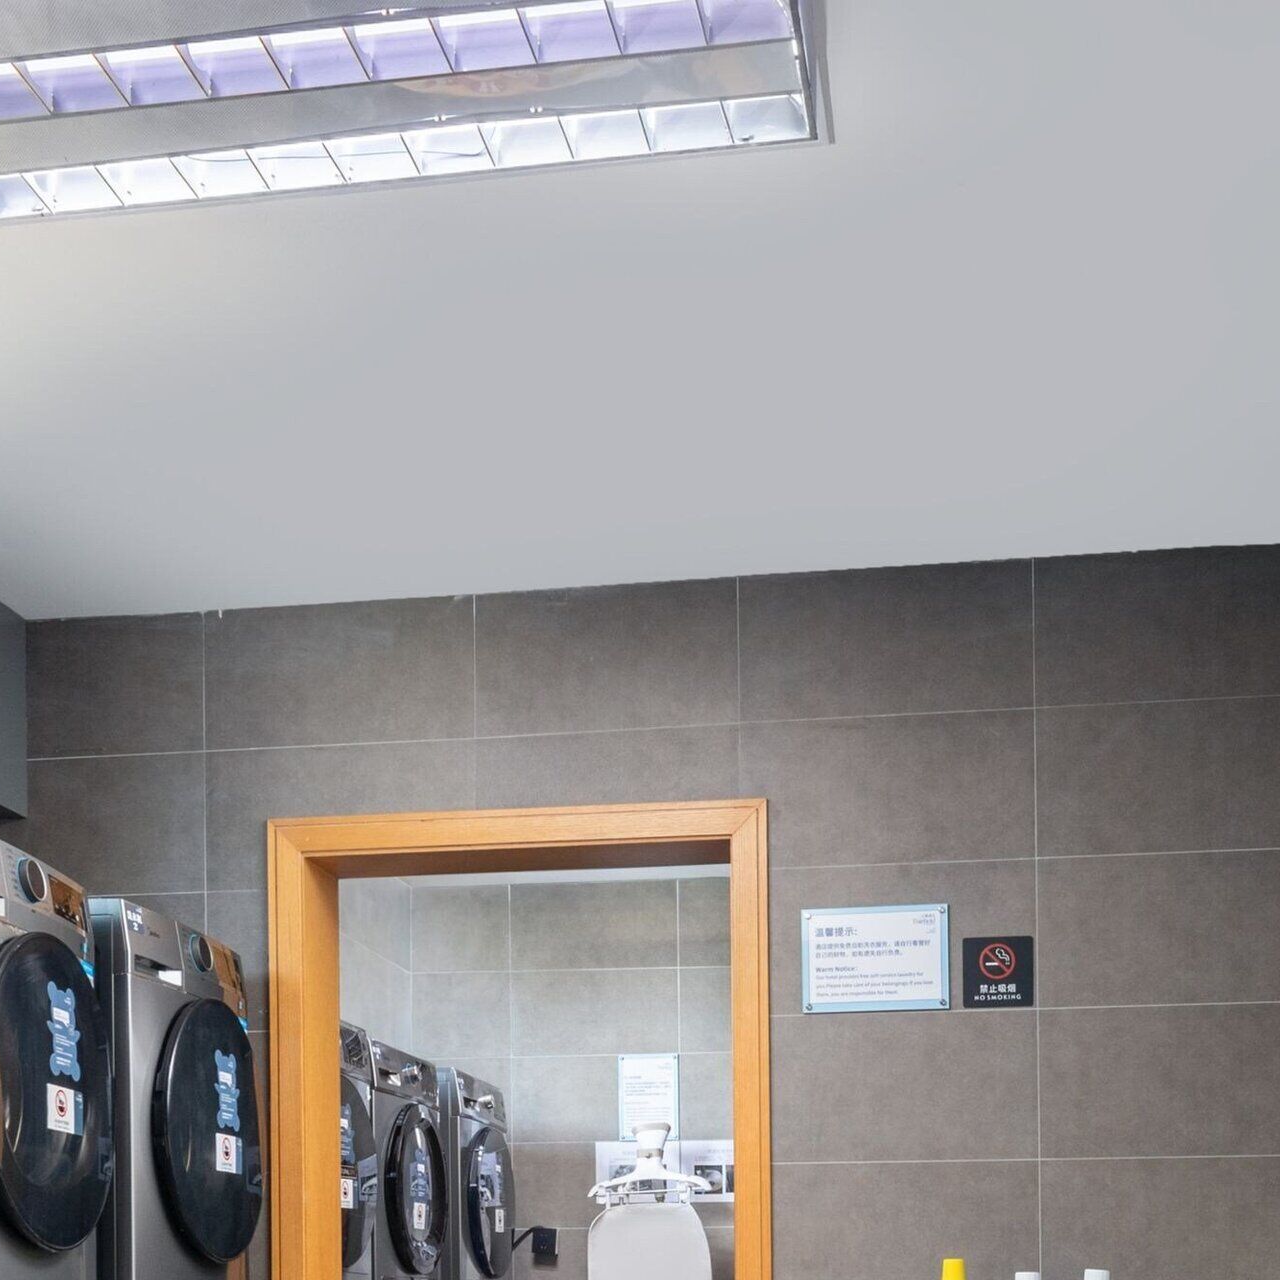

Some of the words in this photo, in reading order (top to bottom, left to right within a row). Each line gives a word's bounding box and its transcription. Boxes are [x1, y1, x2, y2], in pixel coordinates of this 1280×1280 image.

[980, 983, 1016, 993] 禁止吸烟
[987, 993, 1022, 1001] SMOKING
